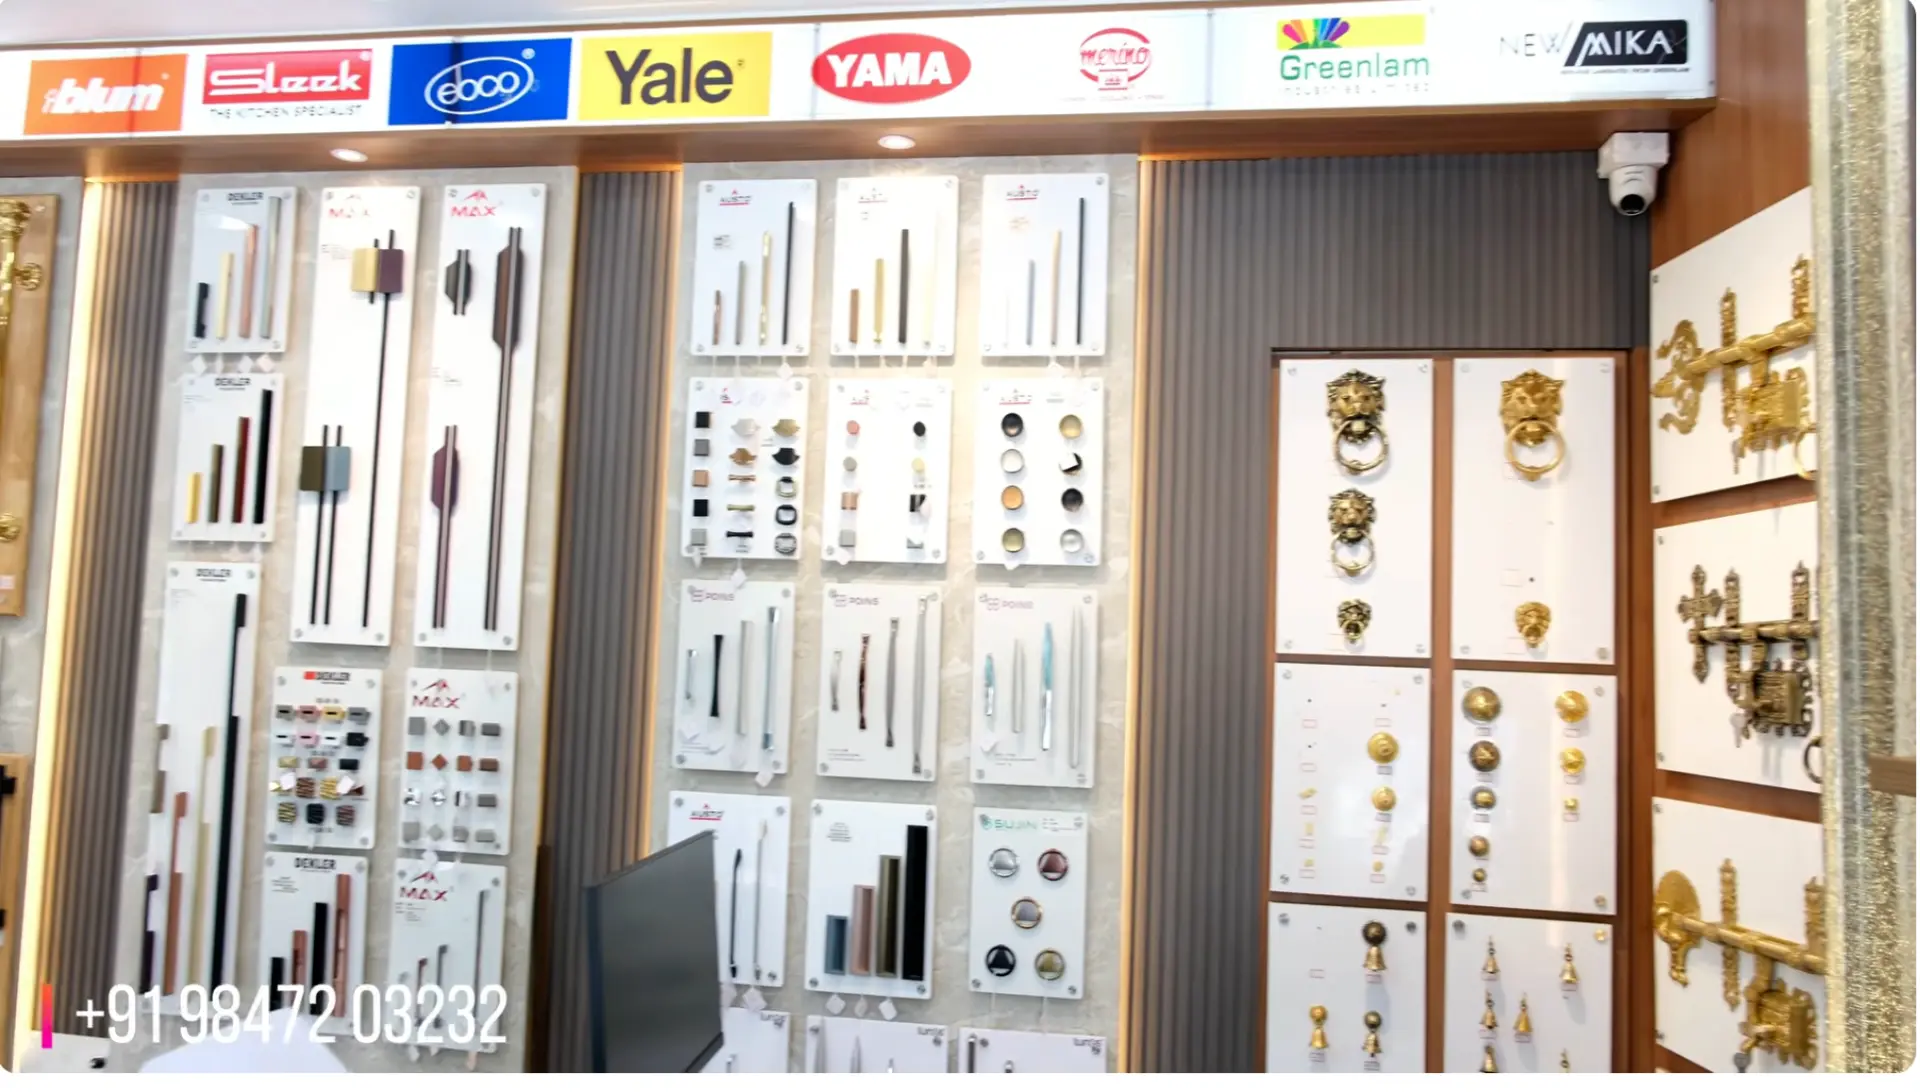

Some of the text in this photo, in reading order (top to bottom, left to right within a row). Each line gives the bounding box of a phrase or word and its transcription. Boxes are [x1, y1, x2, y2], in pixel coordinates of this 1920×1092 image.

[1574, 29, 1674, 66] MIKA
[208, 59, 362, 96] Sleek
[605, 47, 733, 105] Yale
[826, 51, 953, 88] YAMA
[1280, 52, 1430, 80] Greenlam
[450, 205, 496, 217] MAX
[412, 695, 460, 709] MAX
[399, 886, 448, 902] MAX
